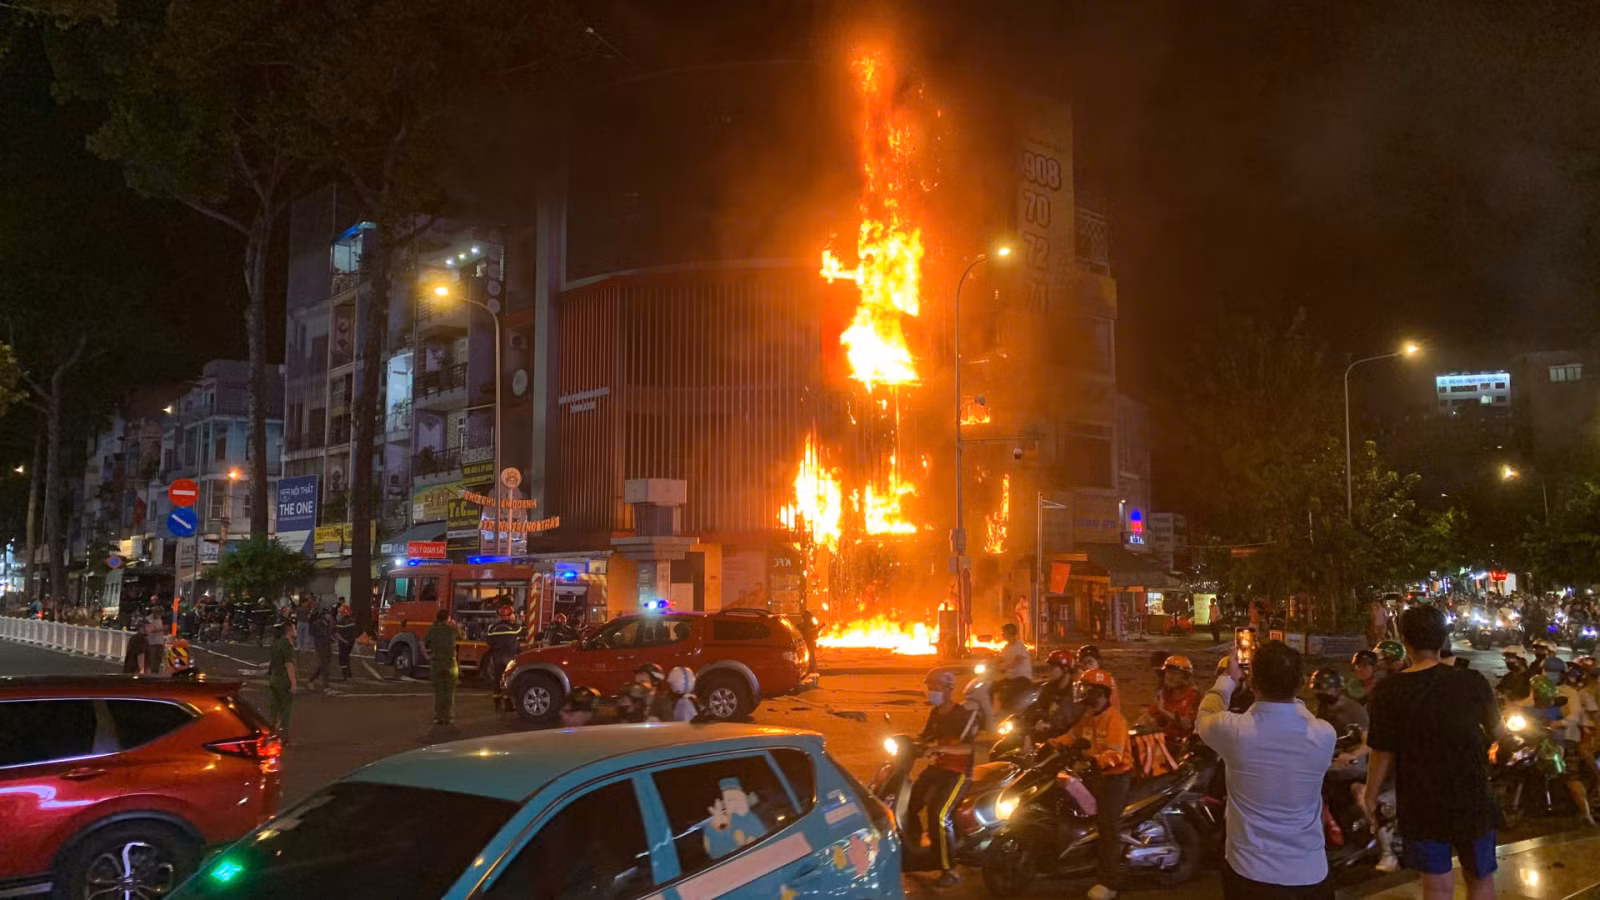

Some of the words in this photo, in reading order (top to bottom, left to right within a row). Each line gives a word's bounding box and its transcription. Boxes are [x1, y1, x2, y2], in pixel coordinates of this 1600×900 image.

[1024, 149, 1061, 191] 908
[1024, 190, 1050, 229] 70
[1024, 232, 1050, 271] 72
[279, 503, 295, 516] THE
[296, 500, 313, 514] ONE
